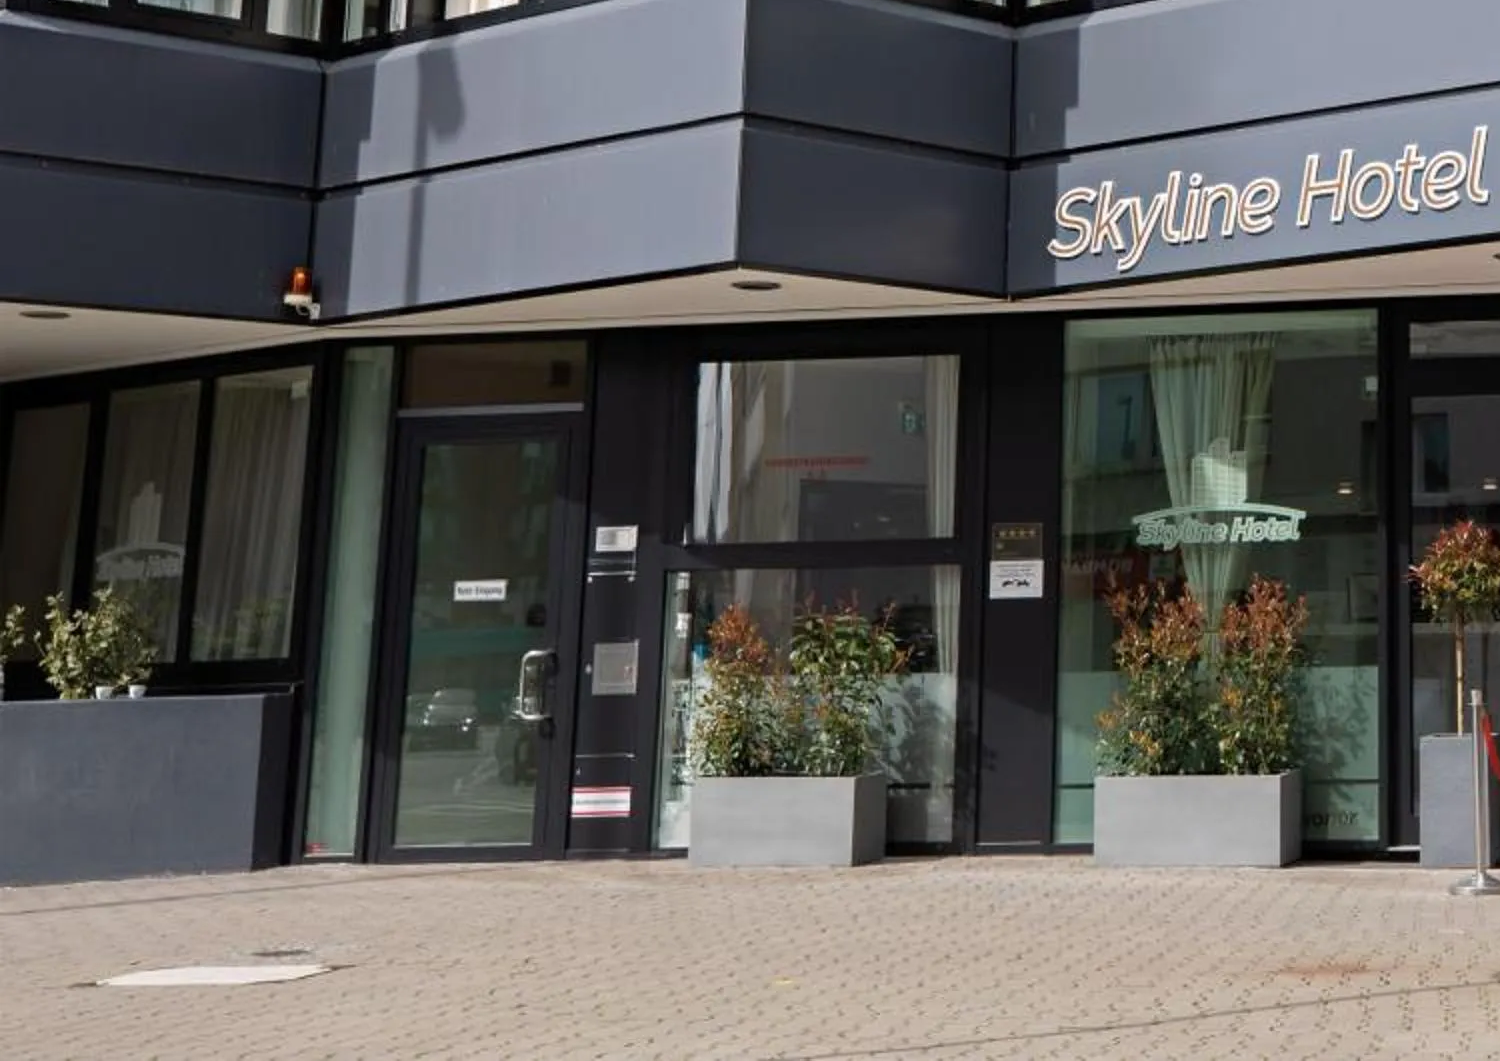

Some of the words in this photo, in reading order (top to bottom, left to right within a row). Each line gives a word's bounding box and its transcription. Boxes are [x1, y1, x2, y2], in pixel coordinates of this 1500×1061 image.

[1047, 169, 1281, 272] Skyline
[1296, 124, 1490, 227] Hotel
[1136, 516, 1228, 551] Skyline
[1229, 515, 1301, 543] Hotel
